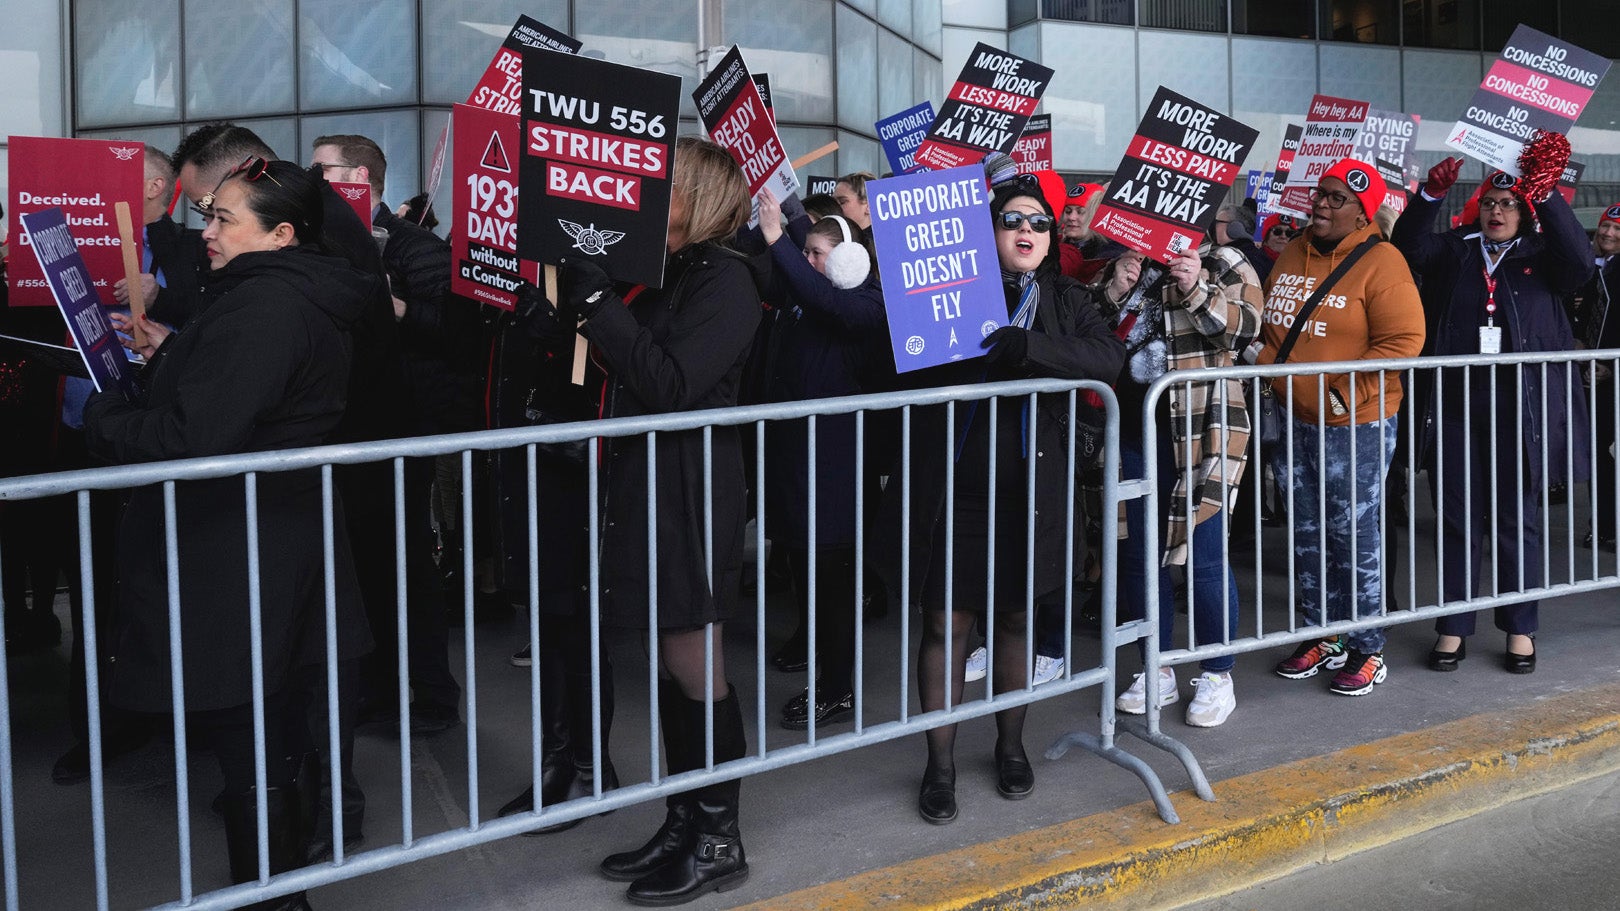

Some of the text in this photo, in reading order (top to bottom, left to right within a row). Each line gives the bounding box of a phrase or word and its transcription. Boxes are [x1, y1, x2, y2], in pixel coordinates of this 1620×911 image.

[512, 30, 532, 45] FLIGHT
[518, 25, 548, 43] AMERICAN
[546, 38, 572, 54] AIRLINES
[974, 52, 1023, 76] MORE
[1504, 46, 1598, 87] CONCESSIONS
[1544, 45, 1567, 62] NO
[501, 76, 522, 100] TO
[700, 59, 740, 108] AMERICAN AIRLINES
[701, 68, 747, 118] FLIGHT ATTENDANTS:
[992, 72, 1042, 98] WORK
[1486, 74, 1580, 116] CONCESSIONS
[1526, 74, 1548, 91] NO
[474, 86, 521, 115] STRIK
[958, 84, 1029, 114] LESS PAY:
[1312, 102, 1364, 120] Hey hey, AA
[530, 88, 666, 138] TWU 556
[714, 96, 756, 149] READY
[880, 108, 934, 140] CORPORATE
[954, 104, 1014, 130] IT'S THE
[1156, 100, 1220, 134] MORE
[1506, 106, 1529, 122] NO
[934, 118, 1014, 151] AA WAY
[1306, 124, 1358, 142] Where is my
[1366, 116, 1414, 137] RYING
[1469, 130, 1498, 147] Association
[531, 126, 662, 172] STRIKES
[734, 132, 756, 162] TO
[898, 130, 926, 152] GREED
[1181, 128, 1244, 164] WORK
[1298, 138, 1354, 160] boarding
[1379, 135, 1410, 152] GET
[1462, 140, 1504, 164] Flight Attendants
[1465, 136, 1496, 153] Professional
[741, 138, 781, 187] TRIKE
[1014, 160, 1050, 174] STRIKE
[1022, 150, 1036, 162] TO
[1140, 140, 1187, 168] LESS
[1186, 154, 1228, 182] PAY:
[550, 166, 636, 205] BACK
[812, 181, 836, 195] MOR
[1136, 163, 1211, 201] IT'S THE
[20, 192, 106, 206] Deceived.
[468, 174, 518, 218] 193
[876, 178, 982, 221] CORPORATE
[1112, 180, 1210, 224] AA WAY
[468, 212, 516, 250] DAYS
[905, 217, 965, 252] GREED
[1110, 219, 1144, 239] Professional
[1112, 213, 1144, 232] Association
[33, 223, 78, 266] CORPORATE
[1107, 226, 1152, 250] Flight Attendants
[462, 266, 470, 278] a
[470, 246, 518, 272] without
[901, 249, 978, 289] DOESN'T
[60, 266, 88, 303] GREED
[1276, 274, 1316, 289] DOPE
[931, 291, 962, 322] FLY
[1265, 297, 1296, 313] AND
[1270, 285, 1347, 309] SNEAKRS
